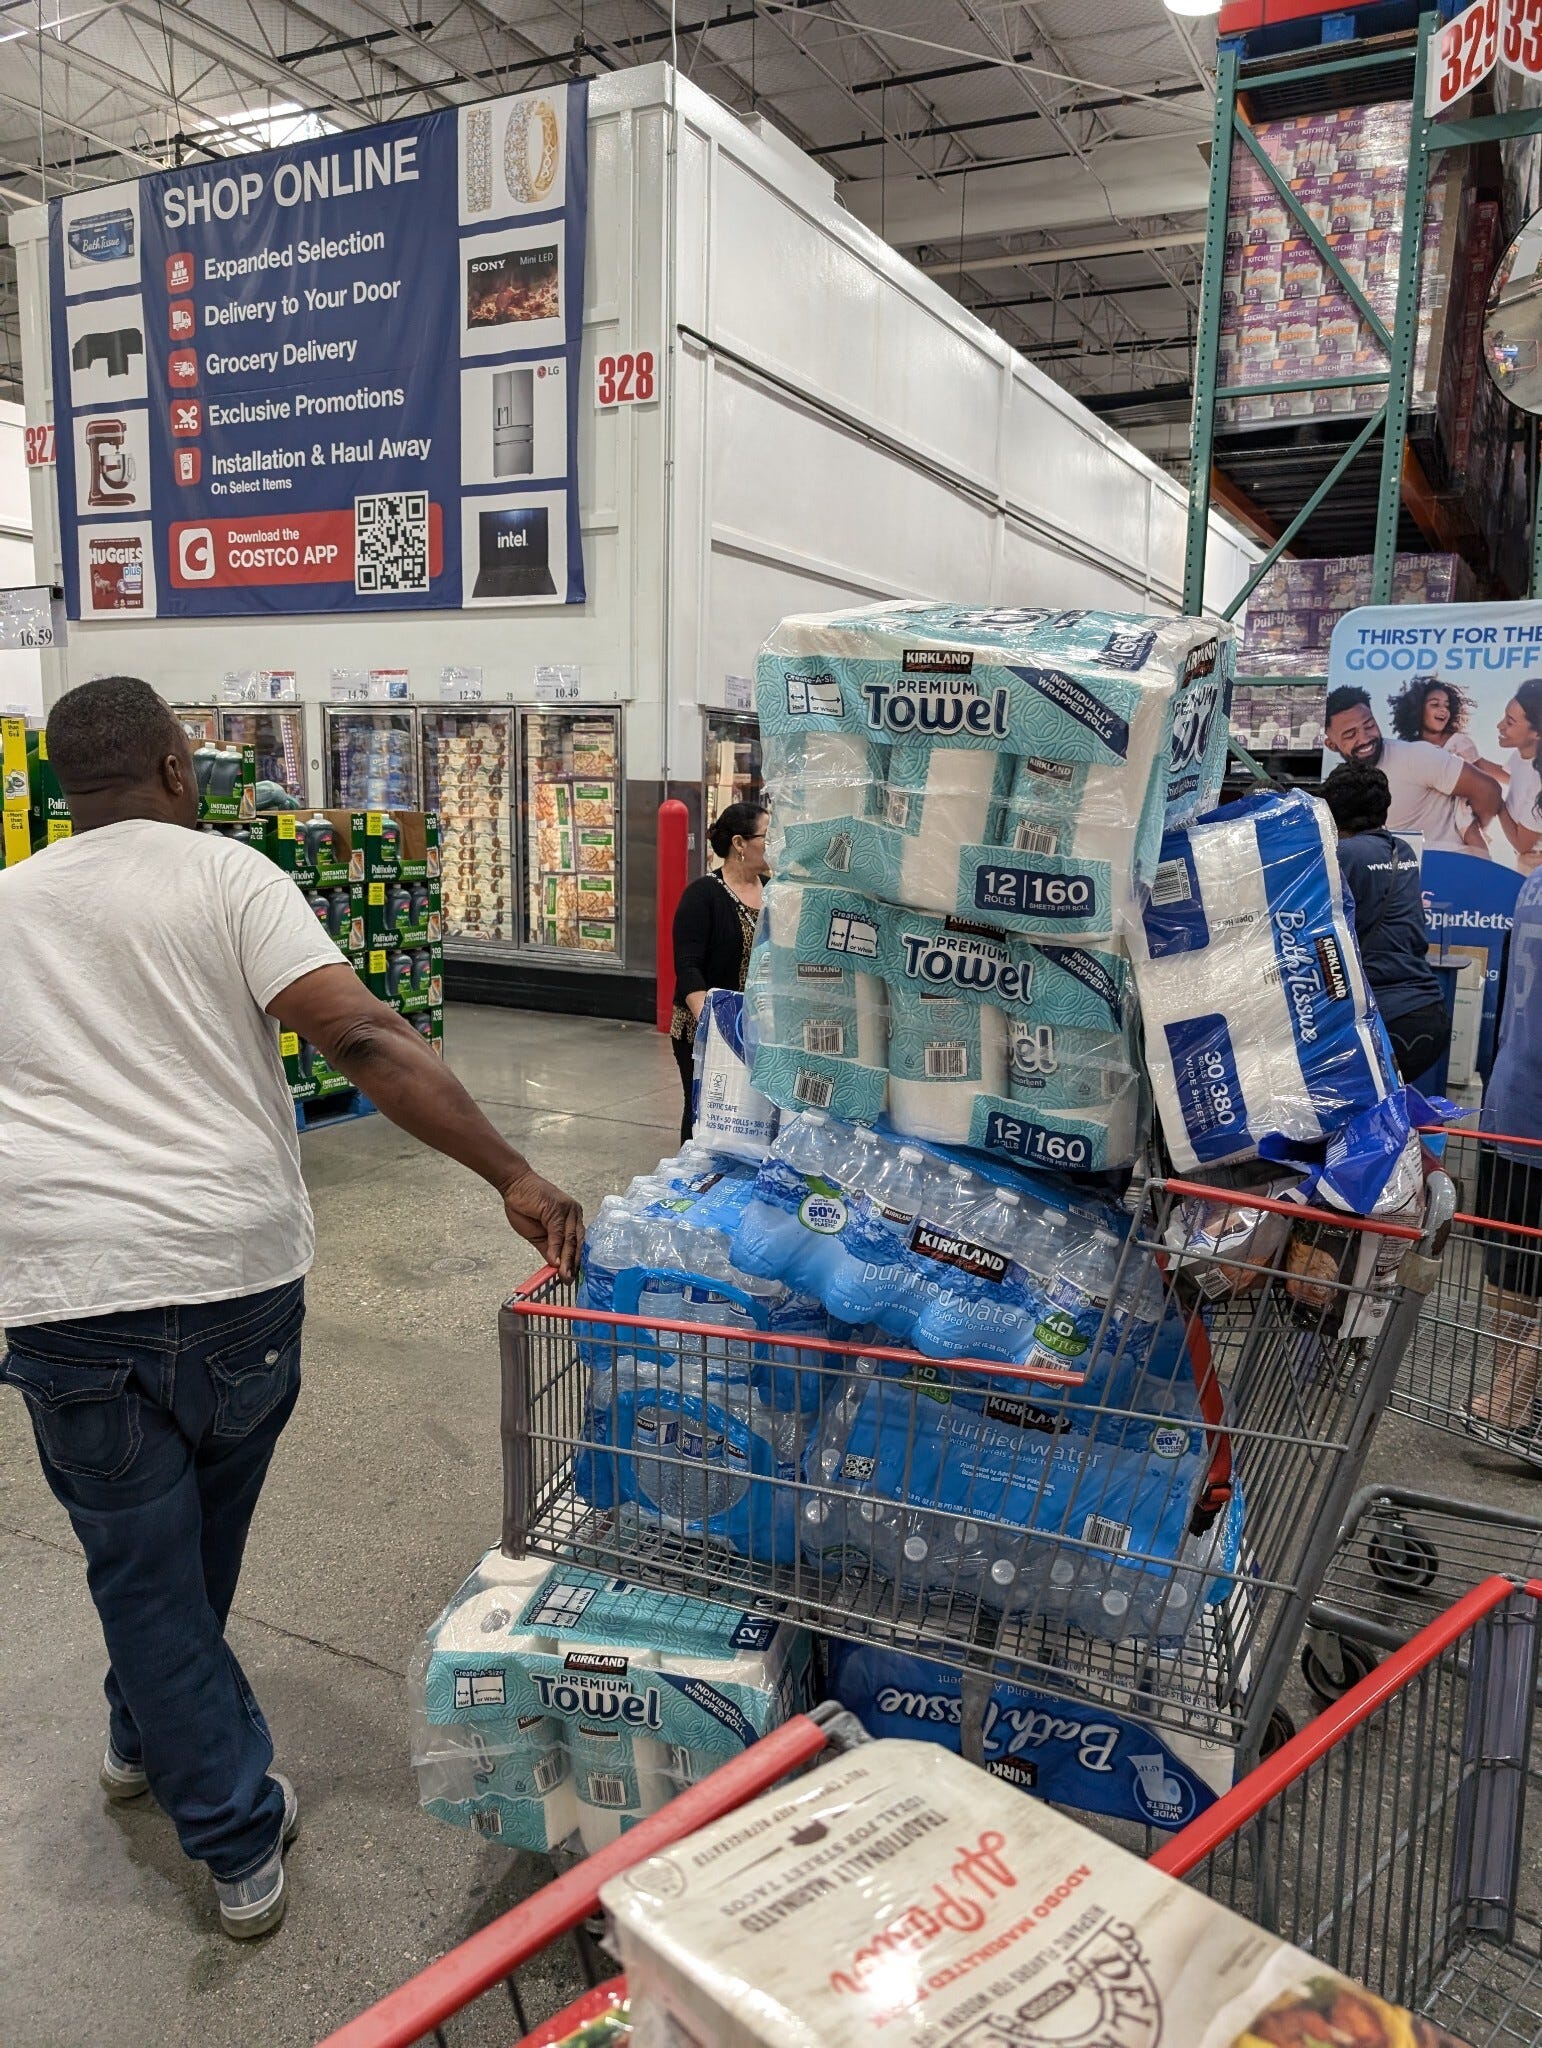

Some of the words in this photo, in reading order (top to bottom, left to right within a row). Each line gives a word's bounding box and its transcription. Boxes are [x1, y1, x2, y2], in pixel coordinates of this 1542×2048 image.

[1440, 0, 1498, 102] 329
[163, 172, 263, 228] SHOP
[274, 136, 419, 207] ONLINE
[204, 245, 292, 281] Expanded
[297, 228, 385, 256] Selection
[471, 259, 506, 273] SONY
[519, 254, 537, 266] Mini
[538, 252, 554, 263] LED
[204, 301, 276, 326] Delivery
[281, 295, 299, 314] to
[304, 287, 347, 312] Your
[353, 279, 401, 305] Door
[206, 350, 278, 376] Grocery
[283, 338, 357, 366] Delivery
[548, 366, 560, 376] LG
[598, 352, 653, 405] 328
[208, 400, 290, 427] Exclusive
[296, 387, 404, 416] Promotions
[212, 447, 306, 476] Installation
[311, 444, 326, 465] &
[331, 440, 373, 464] Haul
[379, 437, 431, 461] Away
[211, 483, 227, 495] On
[229, 480, 260, 494] Select
[261, 477, 292, 491] Items
[228, 529, 280, 544] Download
[282, 528, 299, 541] the
[90, 547, 142, 565] HUGGIES
[229, 547, 299, 568] COSTCO
[303, 545, 338, 565] APP
[20, 628, 53, 646] 16.59
[1358, 628, 1449, 645] THIRSTY
[1452, 627, 1499, 644] FOR
[906, 651, 971, 665] KIRKLAND
[1345, 648, 1438, 671] GOOD
[1445, 647, 1541, 670] STUFF
[348, 689, 369, 699] 14.79
[459, 690, 481, 700] 12.29
[555, 688, 579, 698] 10.49
[897, 680, 975, 693] PREMIUM
[1048, 672, 1114, 725] INDIVIDUALLY
[865, 686, 1007, 734] Towel
[1038, 676, 1084, 716] WRAPPED
[1083, 711, 1113, 740] ROLLS
[1029, 757, 1071, 775] KIRKLAND
[250, 827, 263, 835] 102
[353, 818, 363, 826] 102
[371, 864, 398, 874] Palmolive
[984, 894, 1016, 906] ROLLS
[985, 872, 1017, 896] 12
[1031, 878, 1089, 904] 160
[372, 933, 399, 943] Palmolive
[936, 936, 1011, 963] PREMIUM
[1276, 910, 1307, 975] Bath
[904, 937, 1031, 1002] Towel
[1060, 954, 1104, 993] WRAPPED
[1323, 937, 1347, 999] KIRKLAND
[1288, 966, 1320, 1044] Tissue
[1204, 1051, 1225, 1077] 30
[1185, 1056, 1197, 1084] WIDE
[1191, 1087, 1209, 1131] SHEETS
[1211, 1082, 1235, 1126] 380
[724, 1104, 738, 1112] SAFE
[994, 1117, 1022, 1142] 12
[1035, 1128, 1085, 1162] 160
[808, 1206, 840, 1219] 50%
[918, 1231, 1005, 1272] KIRKLAND
[862, 1263, 953, 1307] purified
[958, 1298, 1032, 1330] water
[933, 1308, 963, 1326] added
[965, 1318, 978, 1332] for
[1045, 1315, 1073, 1338] 40
[1038, 1327, 1081, 1352] BOTTLES
[989, 1396, 1069, 1428] KIRKLAND
[936, 1414, 1024, 1451] purified
[1030, 1445, 1103, 1468] water
[736, 1626, 760, 1645] 12
[568, 1653, 625, 1667] KIRKLAND
[560, 1674, 631, 1693] PREMIUM
[1007, 1684, 1029, 1701] and
[532, 1675, 661, 1727] Towel
[684, 1682, 724, 1718] WRAPPED
[1003, 1709, 1119, 1772] Bath
[1146, 1800, 1183, 1814] SHEETS
[1153, 1809, 1179, 1820] WIDE
[843, 1819, 877, 1845] FOR
[778, 1840, 843, 1882] STREET
[832, 1808, 948, 1887] TRADITIONALLY
[718, 1880, 774, 1917] TACOS
[739, 1876, 833, 1934] MARINATED
[1033, 1863, 1092, 1920] ADOBO
[926, 1916, 1033, 1990] MARINATED
